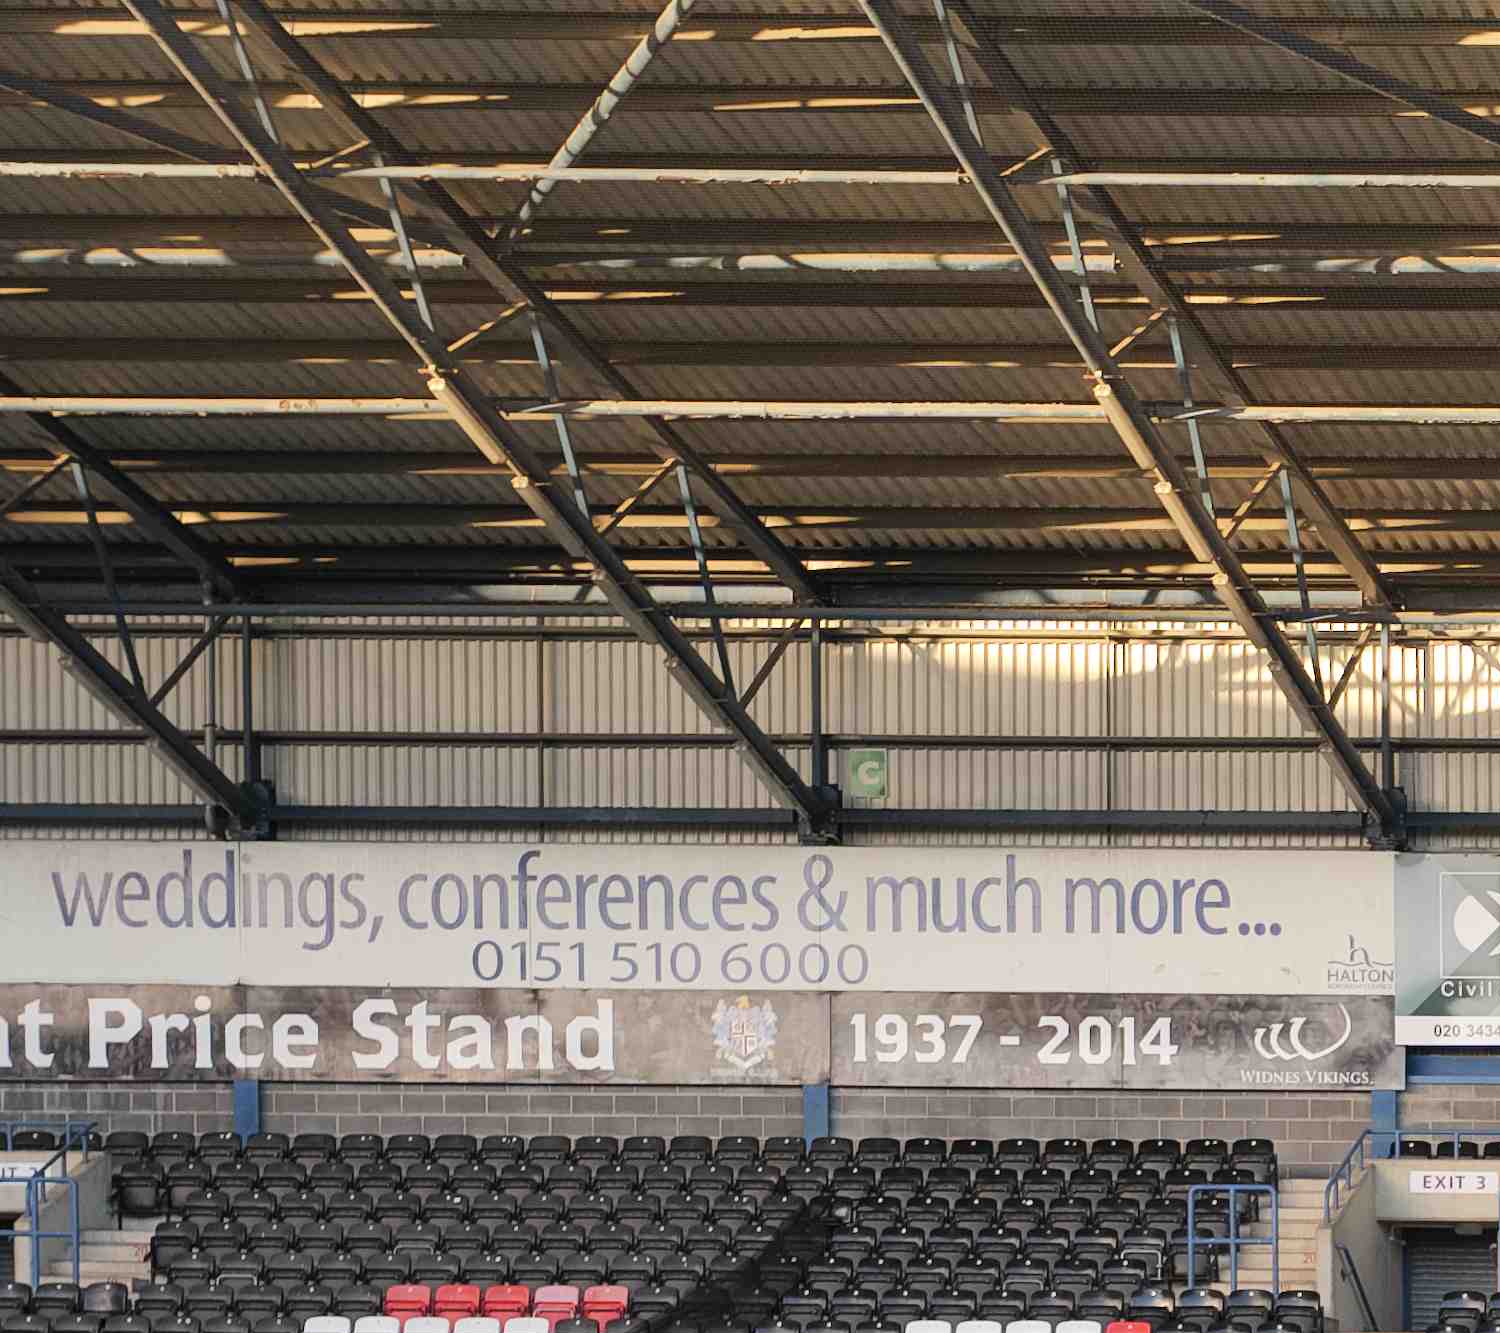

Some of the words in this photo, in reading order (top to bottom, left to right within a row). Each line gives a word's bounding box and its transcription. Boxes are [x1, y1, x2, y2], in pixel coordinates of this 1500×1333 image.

[857, 760, 880, 785] C
[51, 849, 384, 950] weddings,
[399, 850, 777, 931] conferences
[797, 854, 848, 932] &
[866, 854, 1041, 934] much
[1065, 877, 1282, 937] more...
[472, 940, 586, 983] 0151
[609, 942, 702, 984] 510
[720, 942, 869, 984] 6000
[1328, 969, 1393, 982] HALTON
[1441, 980, 1494, 998] Civil
[87, 994, 319, 1070] Price
[352, 997, 616, 1071] Stand
[850, 1013, 984, 1064] 1937
[1036, 1016, 1179, 1066] 2014
[1433, 1024, 1462, 1038] 020
[1241, 1069, 1301, 1086] WIDNES
[1423, 1175, 1466, 1190] EXIT
[1477, 1175, 1486, 1190] 3
